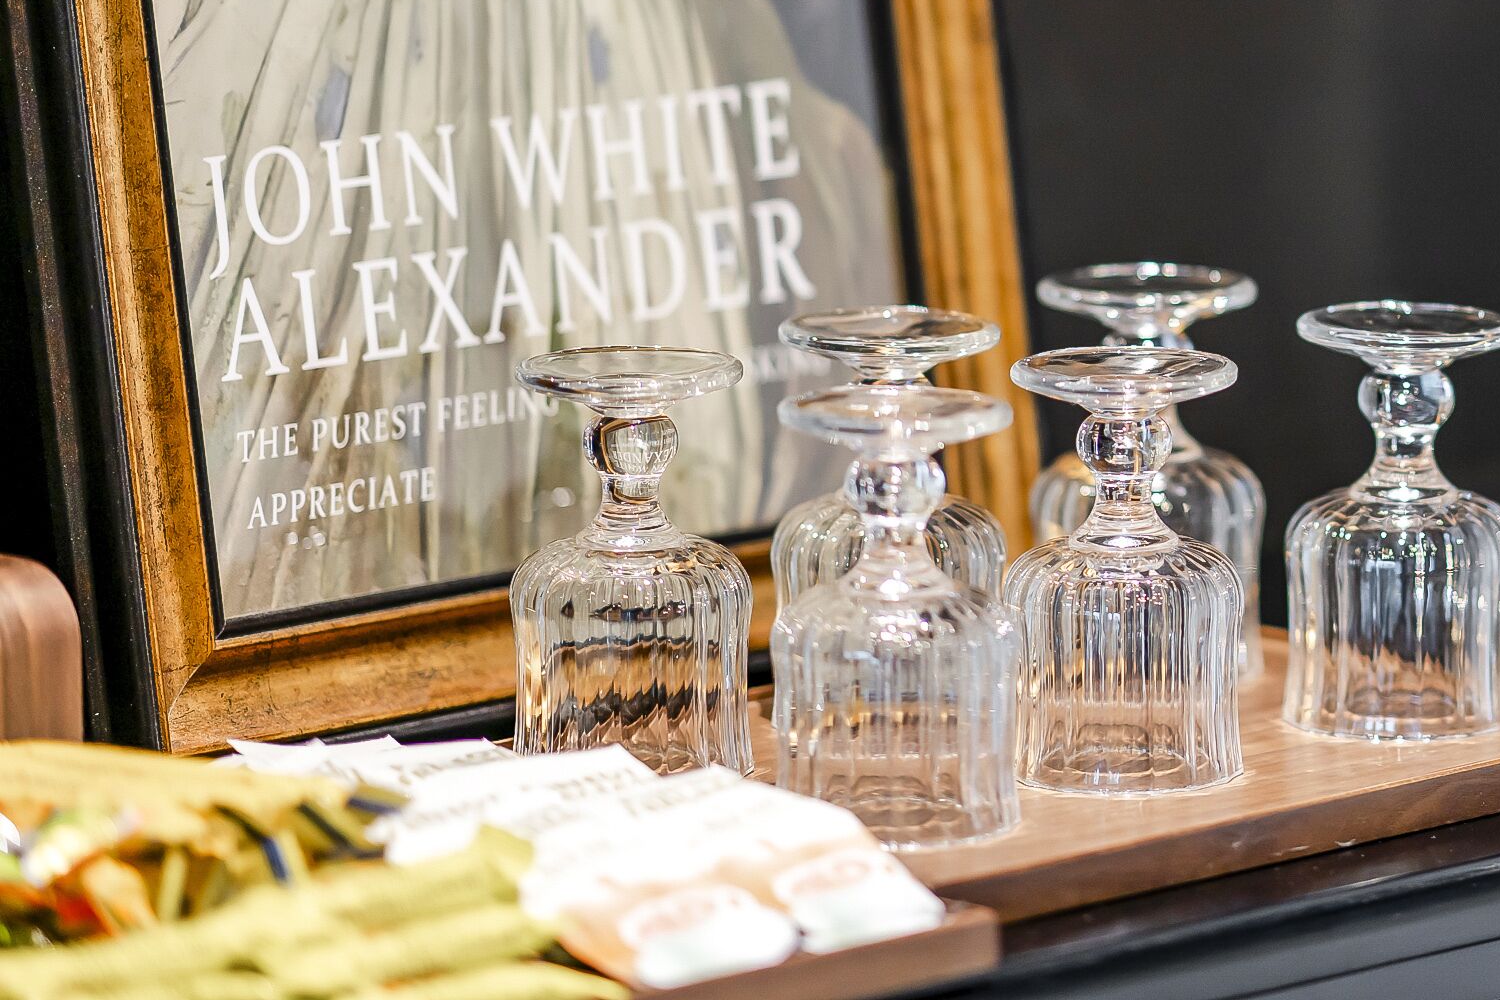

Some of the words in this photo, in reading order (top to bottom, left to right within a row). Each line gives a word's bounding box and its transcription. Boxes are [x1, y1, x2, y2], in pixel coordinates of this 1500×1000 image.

[203, 124, 459, 279] JOHN
[490, 77, 800, 211] WHITE
[221, 198, 816, 382] ALEXANDER
[237, 422, 299, 463] THE
[312, 402, 427, 452] PUREST
[247, 466, 437, 530] APPRECIATE
